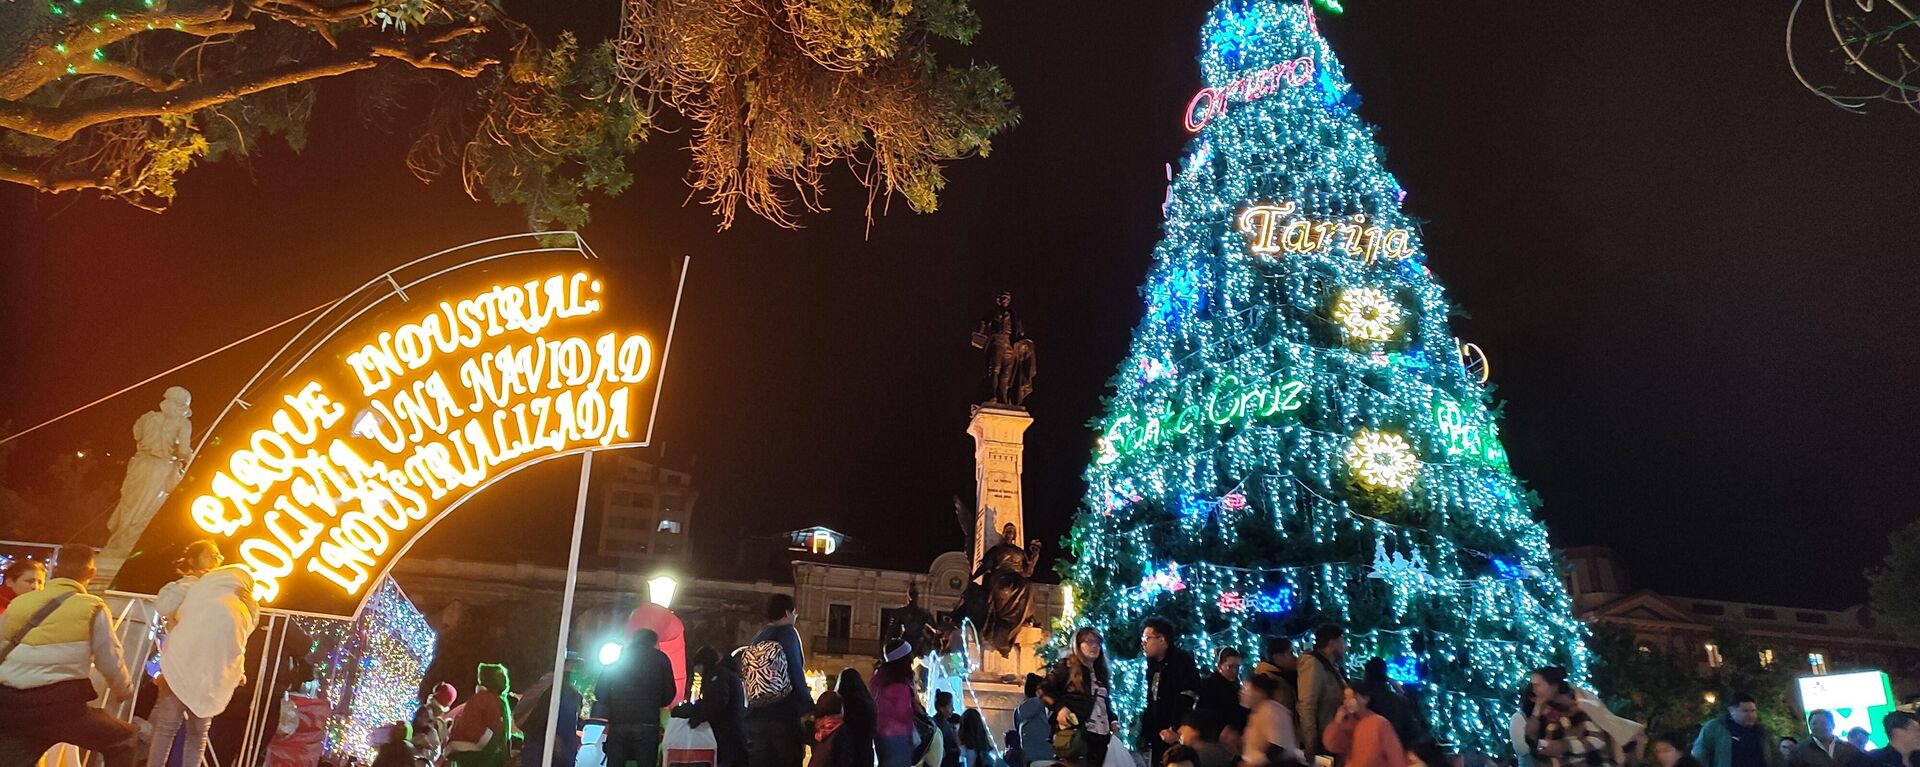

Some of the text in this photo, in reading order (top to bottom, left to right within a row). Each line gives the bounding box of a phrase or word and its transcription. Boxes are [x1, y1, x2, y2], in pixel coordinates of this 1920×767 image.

[1239, 201, 1415, 265] Tarija
[361, 370, 463, 455] UNA
[460, 333, 653, 414] NAVIDAD
[1208, 375, 1307, 425] Cruz
[190, 380, 346, 537] PARQUE
[307, 387, 630, 596] INDUSTRIALIZADA
